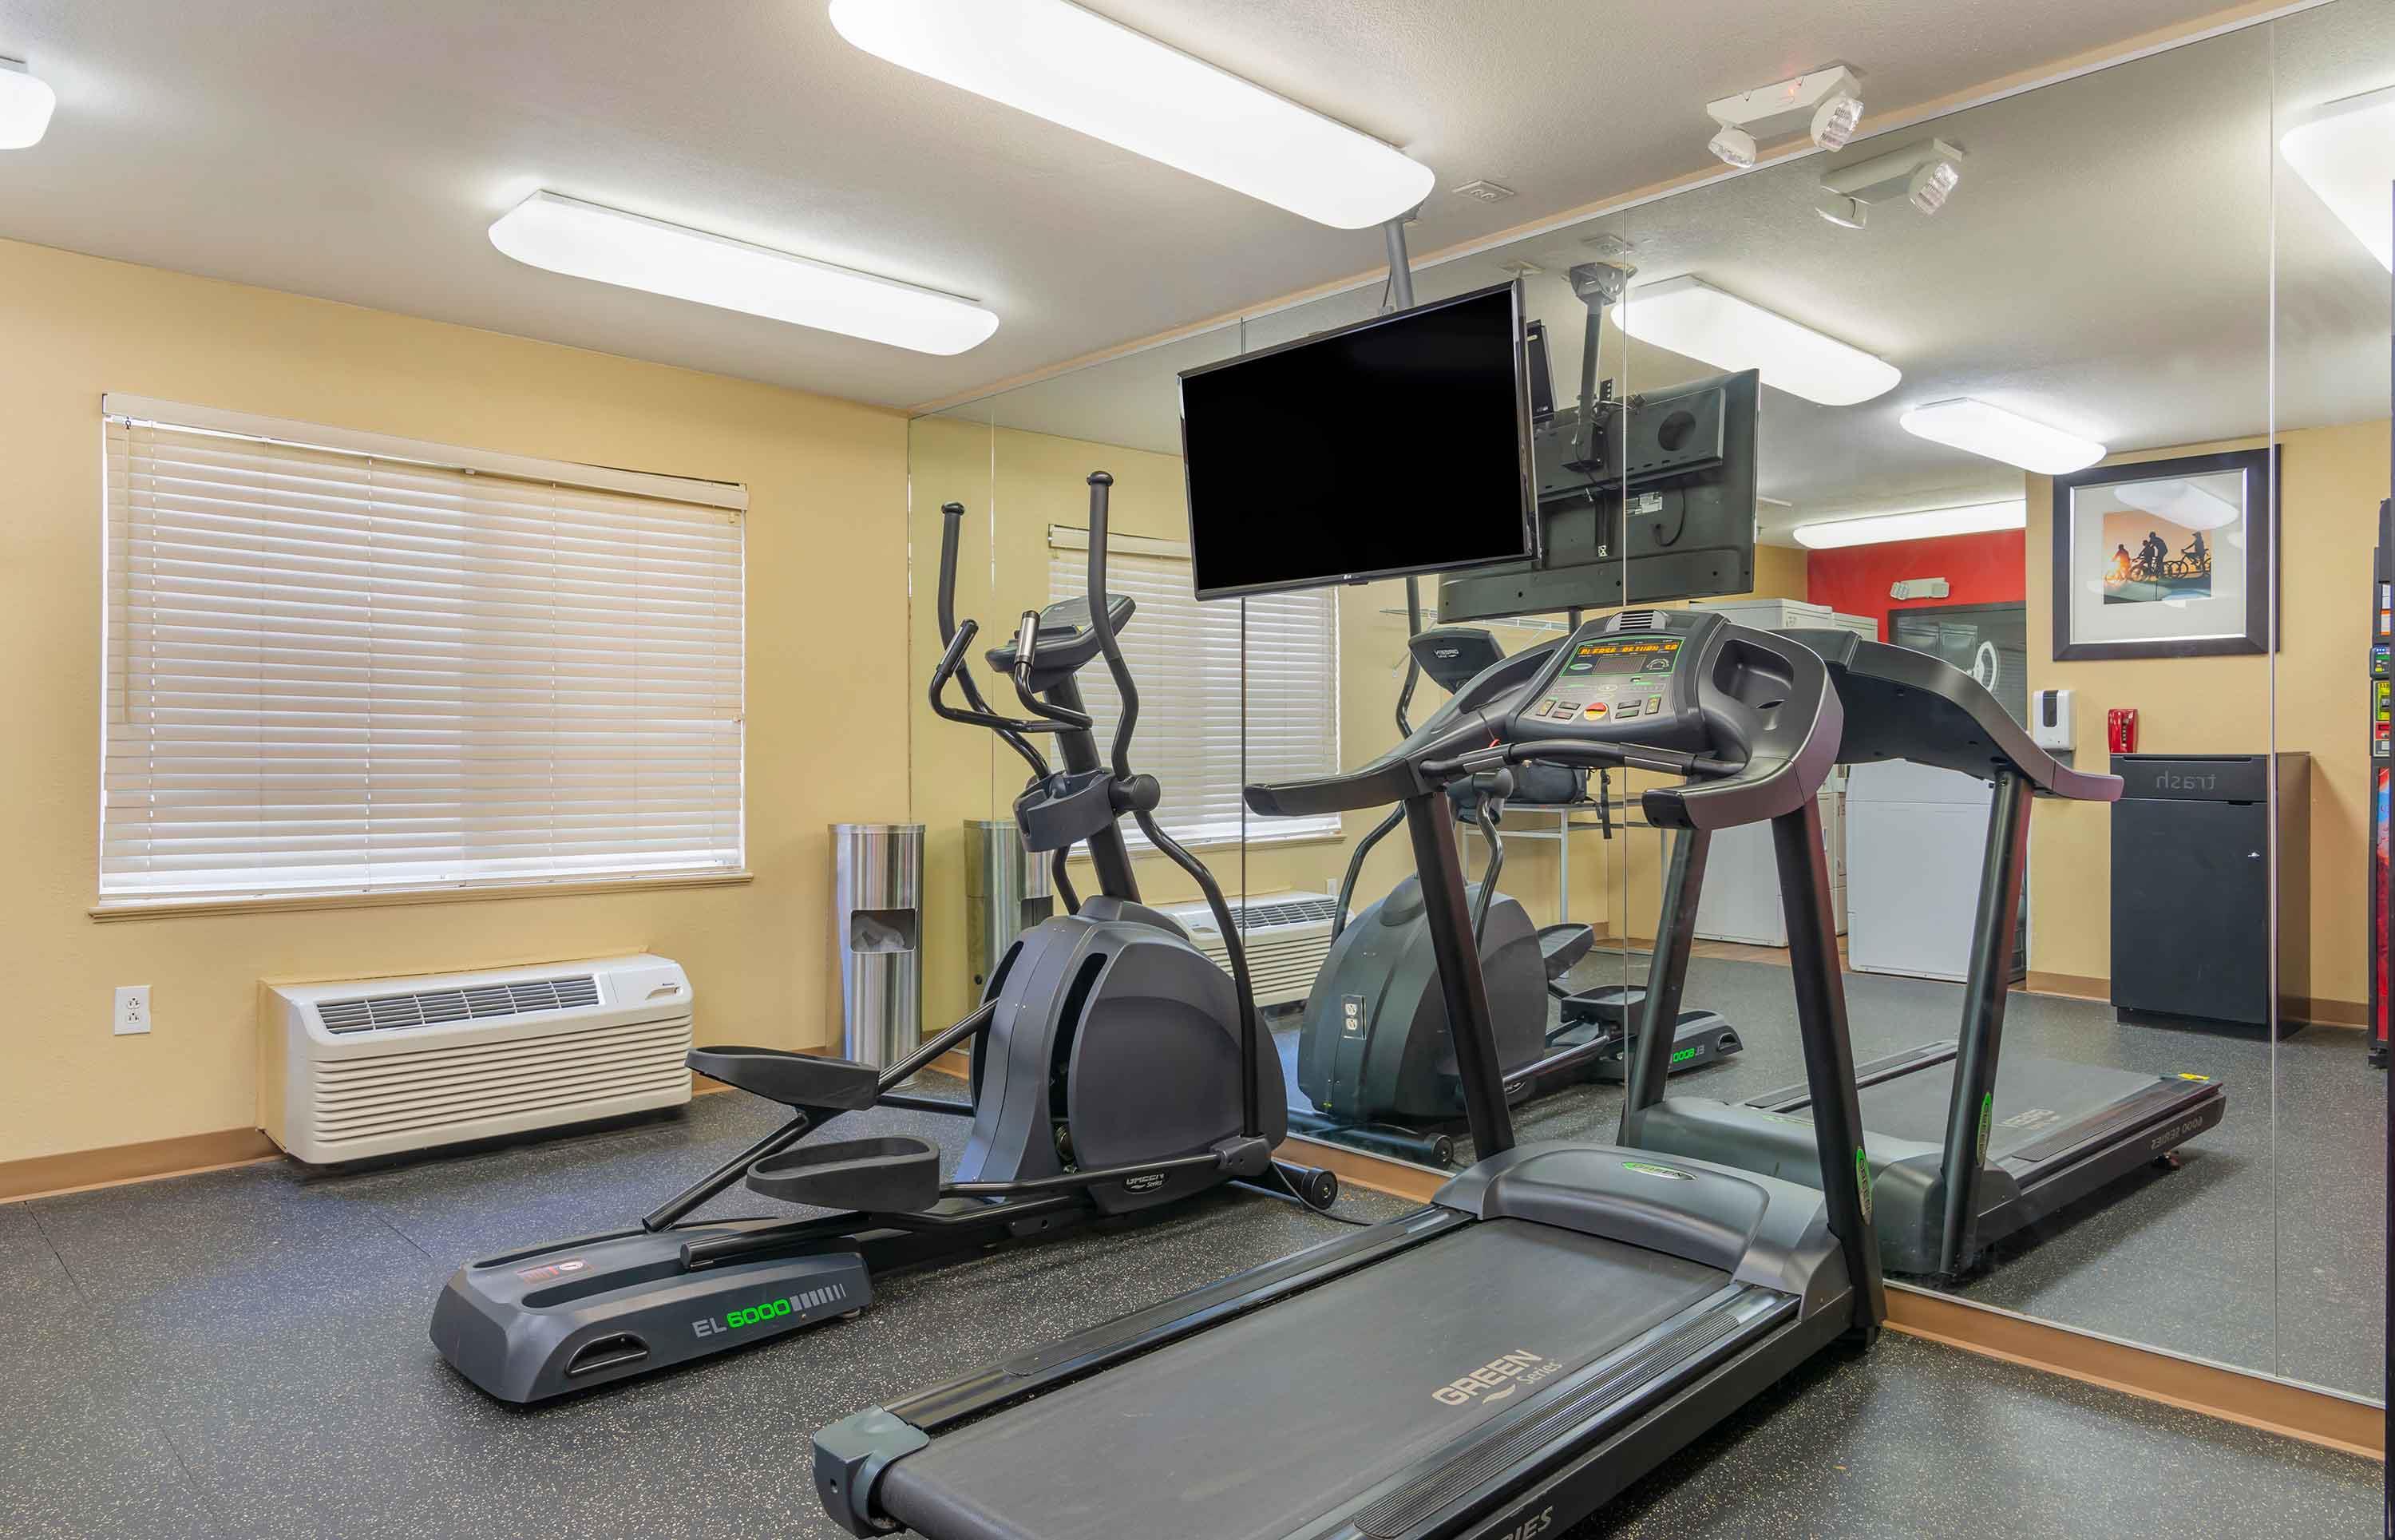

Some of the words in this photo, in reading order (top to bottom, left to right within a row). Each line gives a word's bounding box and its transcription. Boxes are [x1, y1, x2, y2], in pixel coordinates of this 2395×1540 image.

[1431, 1348, 1542, 1406] GREEN
[1517, 1358, 1563, 1385] Series
[1501, 1506, 1553, 1540] IES
